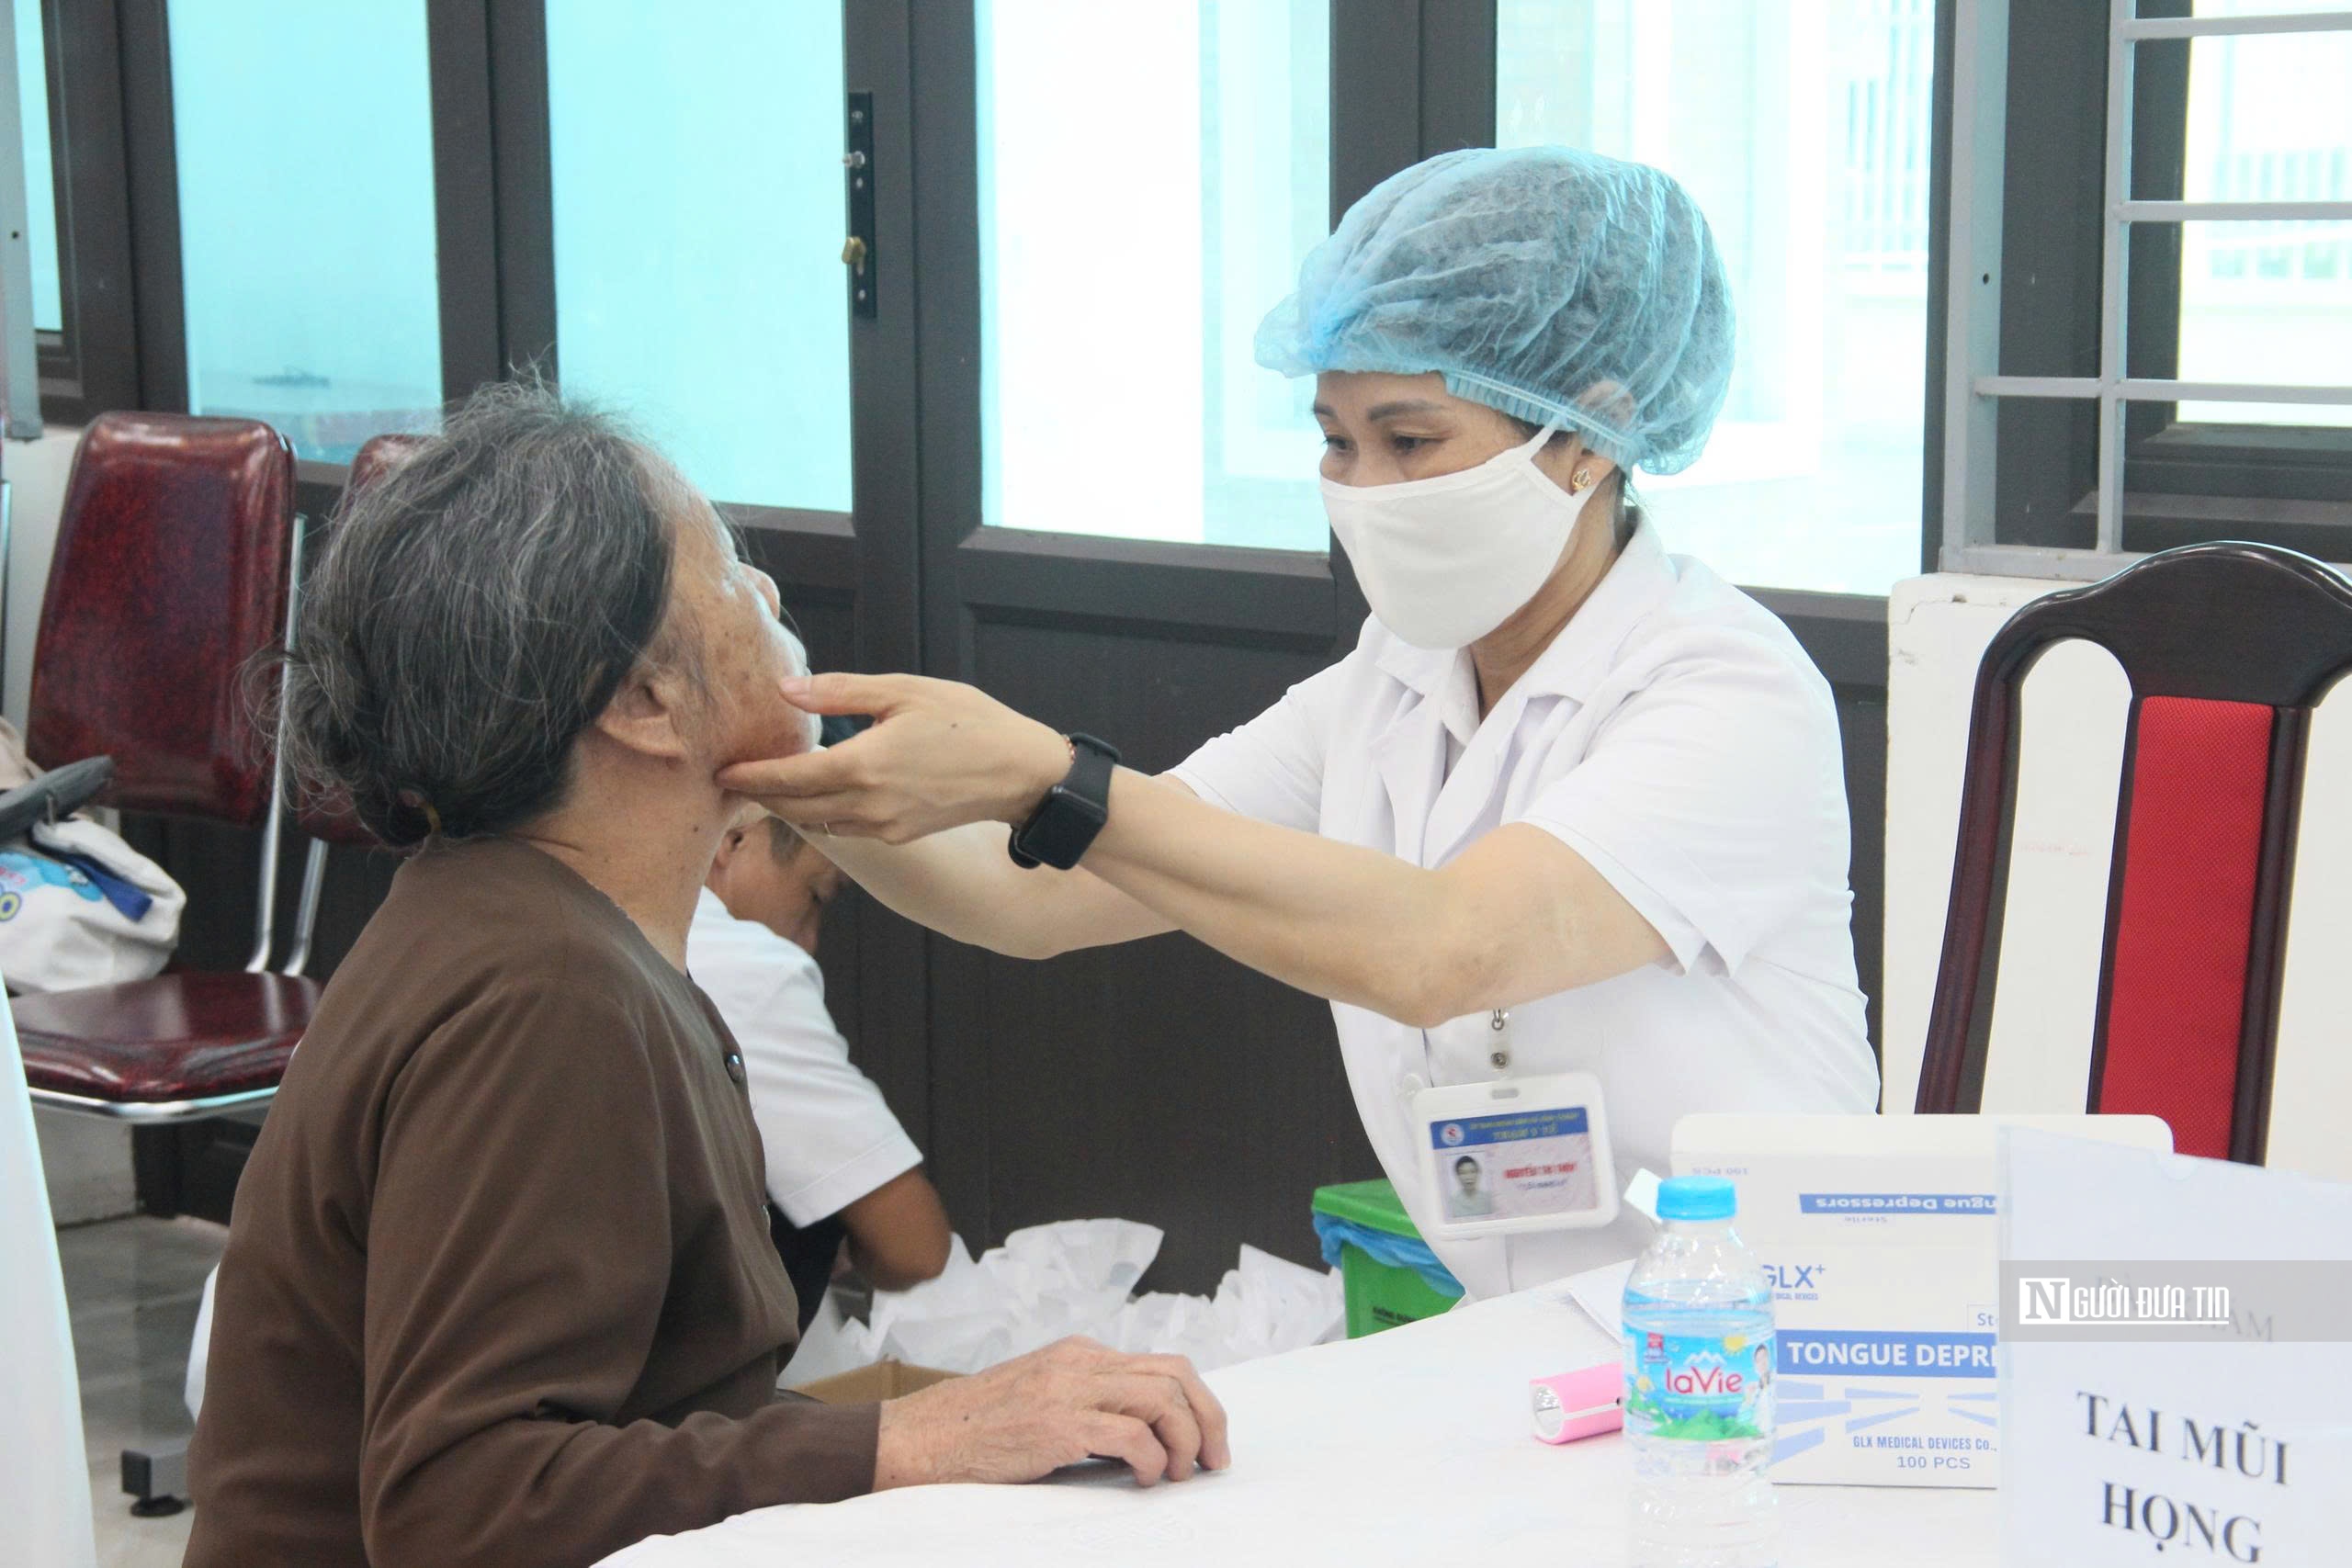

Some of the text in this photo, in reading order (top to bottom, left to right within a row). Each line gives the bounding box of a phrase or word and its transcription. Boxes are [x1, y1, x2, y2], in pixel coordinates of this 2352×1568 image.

[1815, 1196, 1996, 1211] ngue Depressors
[1787, 1341, 1908, 1367] TONGUE
[1665, 1365, 1743, 1394] laVie
[1853, 1435, 1873, 1449] GLX
[1877, 1436, 1924, 1450] MEDICAL
[1928, 1437, 1972, 1450] DEVICES
[2076, 1390, 2290, 1485] TAI MŨI
[1897, 1456, 1971, 1470] 100 PCS
[2099, 1481, 2263, 1564] HỌNG
